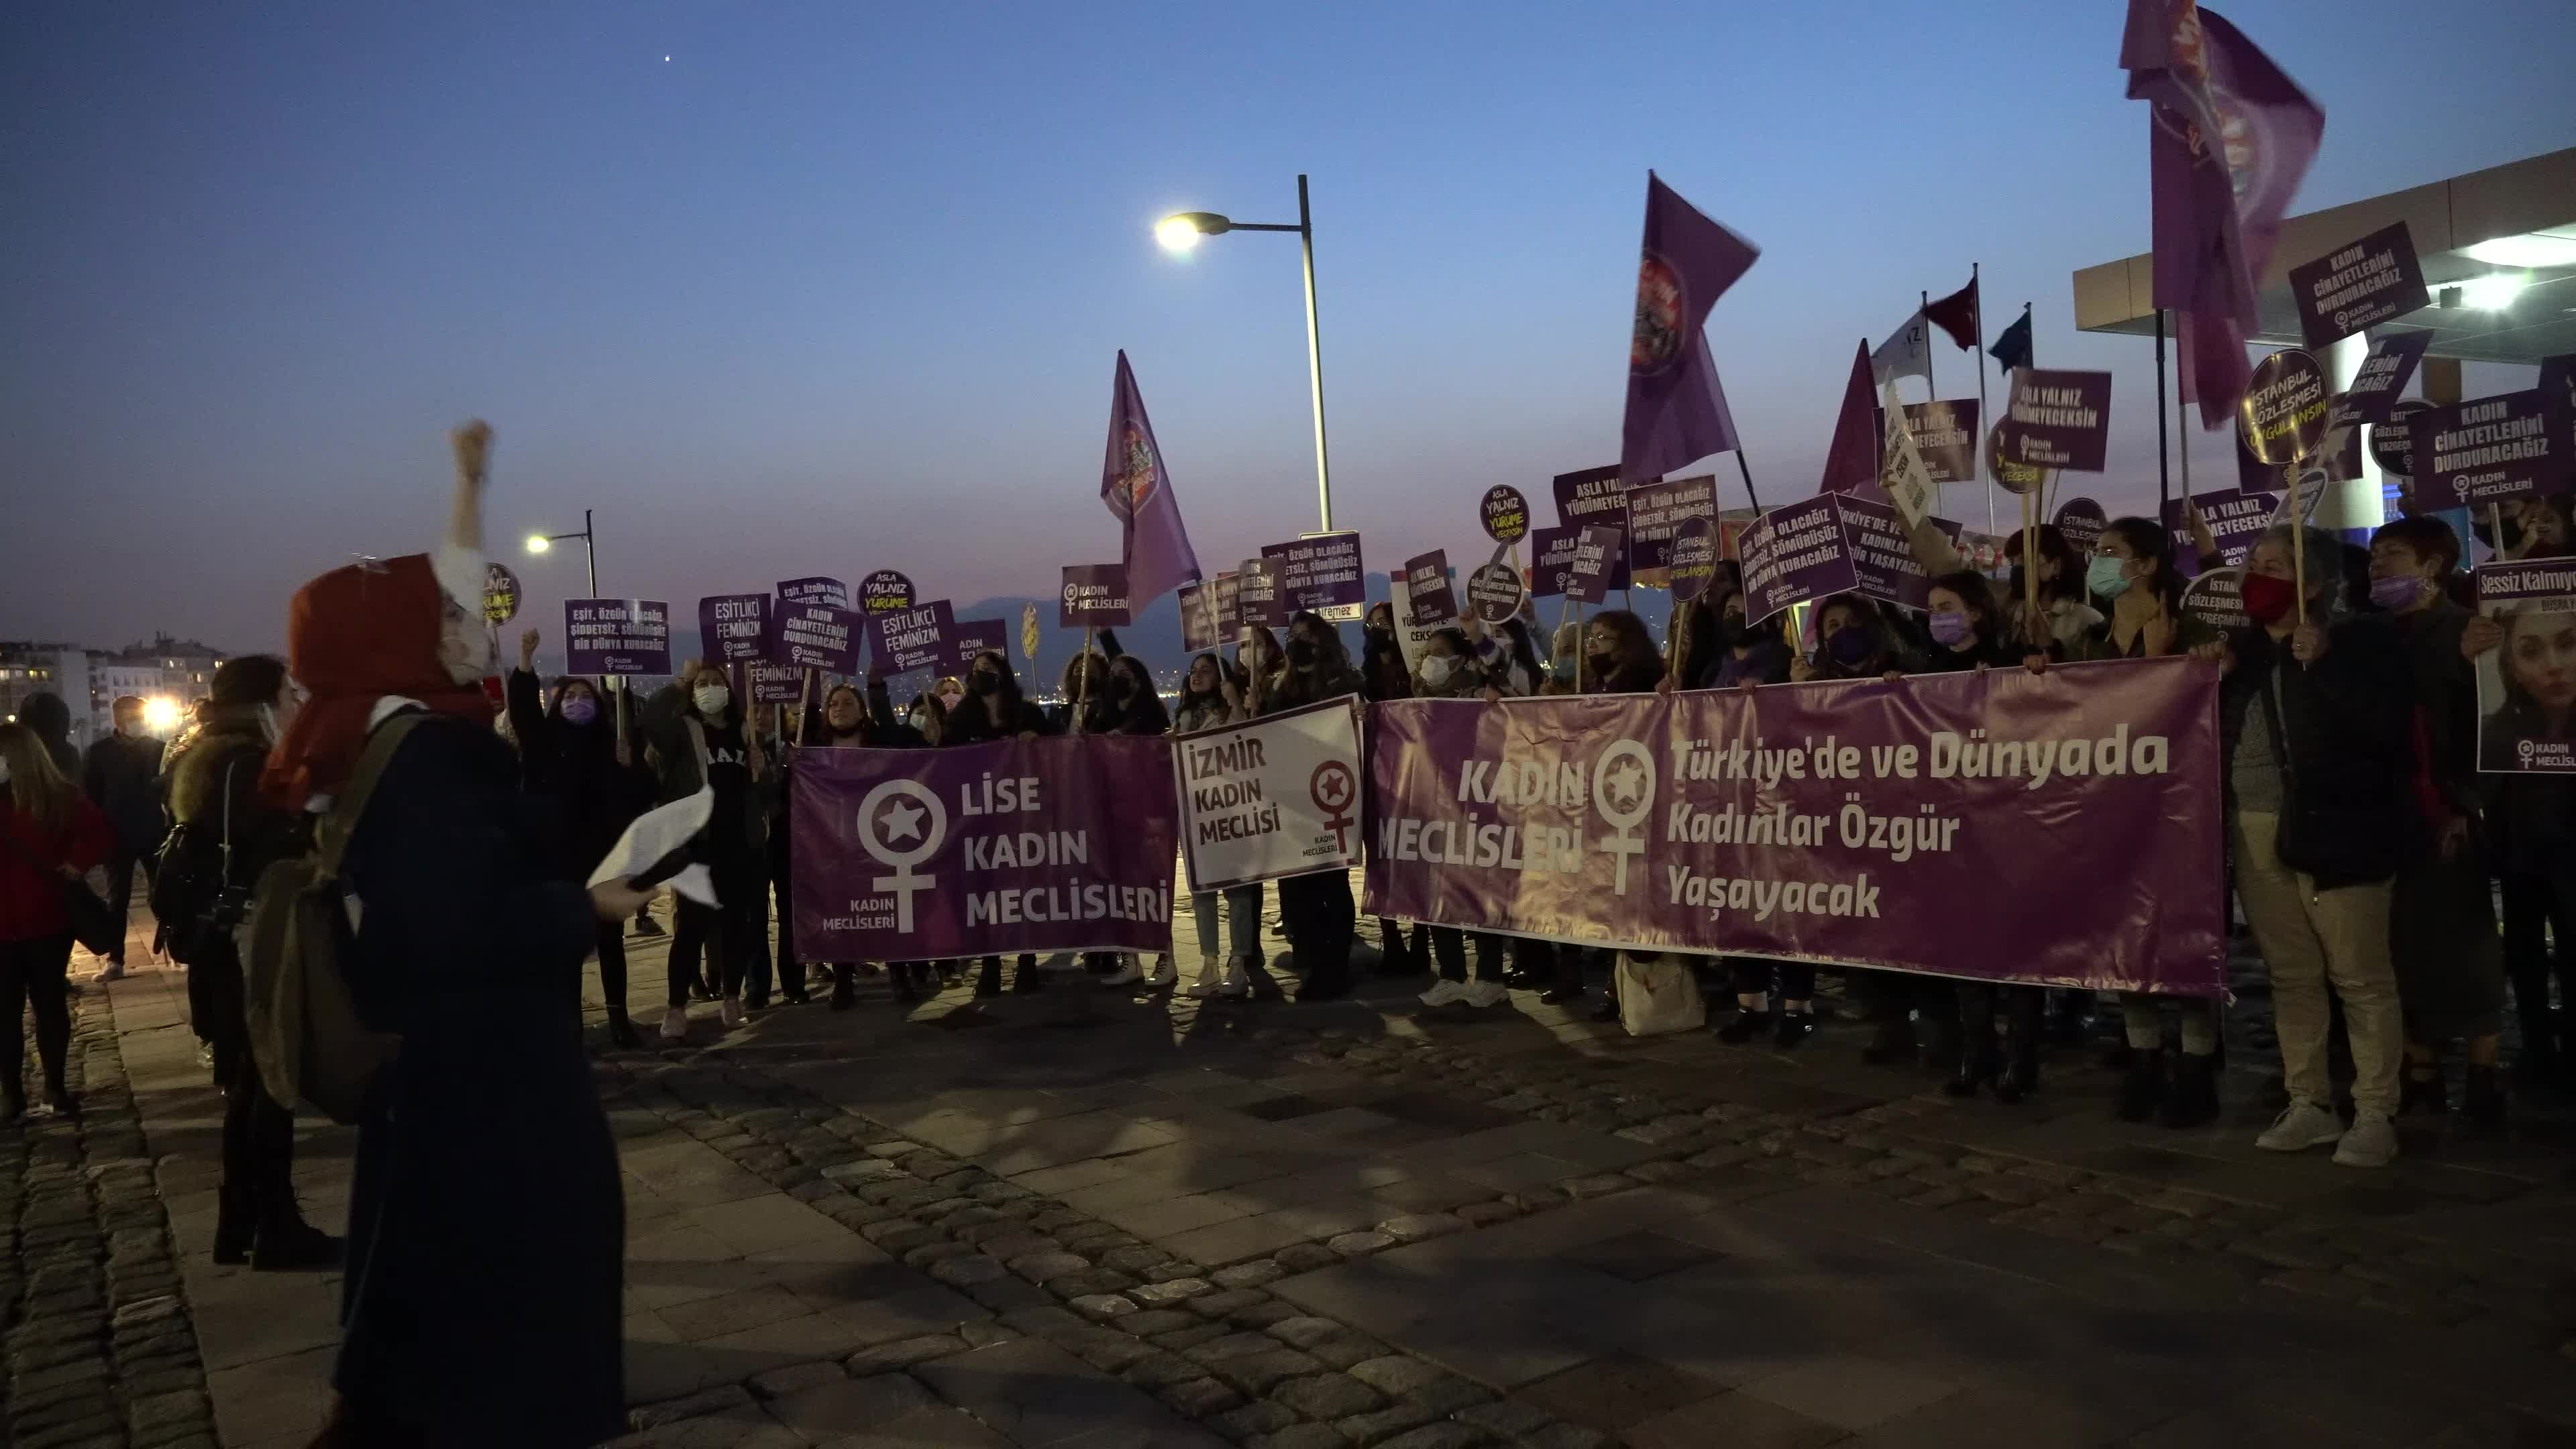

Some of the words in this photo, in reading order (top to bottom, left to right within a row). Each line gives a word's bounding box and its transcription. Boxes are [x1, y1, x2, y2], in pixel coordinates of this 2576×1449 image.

[2329, 245, 2365, 272] KADIN
[2316, 267, 2402, 315] DURDURACAĞIZ
[2348, 301, 2374, 318] KADIN
[2257, 376, 2321, 425] ÖZLEŞMESİ
[2461, 401, 2507, 426] KADIN
[2434, 413, 2544, 452] CİNAYETLERİNİ
[2434, 437, 2549, 473] DURDURACAĞIZ
[2471, 471, 2506, 486] KADIN
[2472, 478, 2533, 498] MECLİSLERİ
[1492, 489, 1508, 499] ASLA
[1576, 481, 1602, 498] ASLA
[1675, 488, 1711, 504] OLACAĞIZ
[1487, 498, 1519, 515] YALNIZ
[1565, 494, 1626, 516] YÜRÜMEYEC
[2200, 506, 2217, 521] LA
[2219, 498, 2262, 517] YALNIZ
[1489, 512, 1524, 529] YÜRÜME
[1778, 508, 1831, 535] OLACAĞIZ
[1839, 506, 1888, 531] ÜRKİYE'DE
[1316, 541, 1354, 557] OLACAĞIZ
[1552, 537, 1574, 551] ASLA
[1772, 525, 1839, 557] SÖMÜRÜSÜZ
[1860, 533, 1911, 555] KADINLAR
[1309, 555, 1358, 573] SÖMÜRÜSÜZ
[1778, 544, 1840, 575] KURACAĞIZ
[1313, 570, 1357, 586] KURACAĞIZ
[1863, 574, 1884, 584] KADIN
[2481, 572, 2521, 594] Sessiz
[866, 583, 907, 594] YALNIZ
[1079, 586, 1108, 596] KADIN
[1774, 584, 1793, 595] KADIN
[1776, 586, 1810, 602] MECLİSLERİ
[715, 598, 760, 621] EŞİTLİKÇİ
[865, 595, 909, 609] YÜRÜME
[1078, 596, 1128, 610] MECLİSLERİ
[599, 608, 627, 621] ÖZGÜR
[806, 608, 833, 623] KADIN
[881, 606, 936, 635] EŞİTLİKÇİ
[716, 619, 761, 639] FEMİNİZM
[787, 616, 848, 639] CİNAYETLERİNİ
[1411, 631, 1431, 641] CEKS
[574, 638, 590, 650] BİR
[592, 638, 621, 650] DÜNYA
[784, 631, 848, 651] DURDURACAĞIZ
[885, 627, 940, 653] FEMİNİZM
[959, 639, 983, 649] ADIN
[802, 649, 822, 658] KADIN
[905, 650, 924, 660] KADIN
[750, 664, 804, 682] FEMİNİZM
[1189, 734, 1267, 780] İZMİR
[1670, 735, 1862, 792] Türkiye'de
[1871, 742, 1919, 778] ve
[1929, 722, 2169, 790] Dünyada
[2535, 743, 2569, 754] KADIN
[2536, 754, 2576, 767] MECLİSL
[1457, 759, 1585, 806] KADIN
[961, 771, 1041, 816] LİSE
[1194, 778, 1262, 813] KADIN
[1199, 802, 1281, 845] MECLİSİ
[1667, 801, 1830, 849] Kadınlar
[1839, 792, 1960, 862] Özgür
[1314, 835, 1336, 844] KADIN
[1378, 812, 1582, 873] MECLİSLERİ
[964, 830, 1087, 871] KADIN
[1303, 845, 1337, 857] MECLİSLERİ
[1667, 863, 1880, 922] Yaşayacak
[850, 898, 894, 912] KADIN
[967, 877, 1168, 928] MECLİSLERİ
[823, 914, 895, 931] MECLİSLERİ
